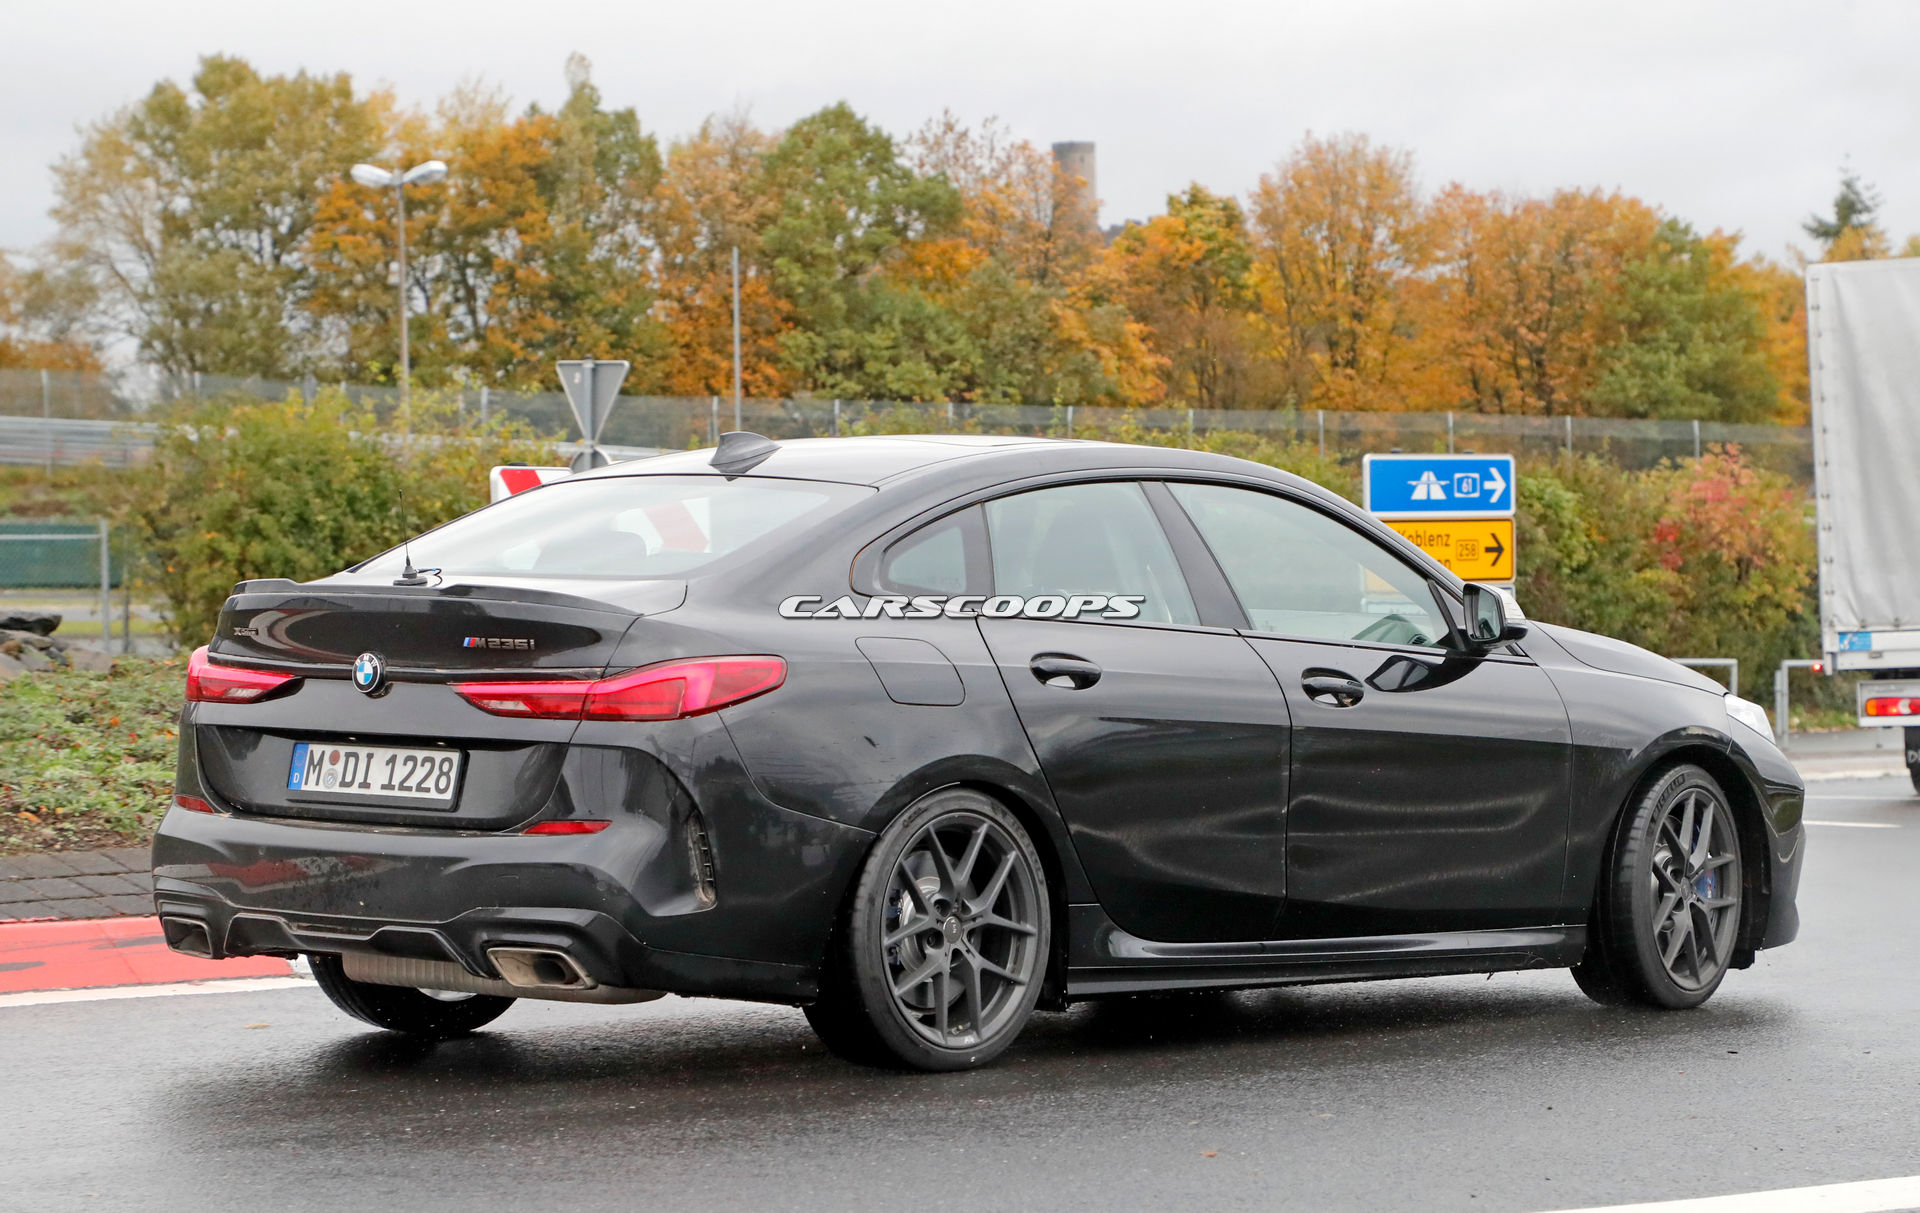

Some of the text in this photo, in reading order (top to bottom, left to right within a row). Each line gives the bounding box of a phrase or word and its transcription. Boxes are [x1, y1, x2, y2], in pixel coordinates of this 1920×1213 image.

[1461, 478, 1473, 493] 61
[1458, 543, 1477, 558] 258
[293, 772, 300, 784] D
[304, 750, 454, 795] M DI 1228
